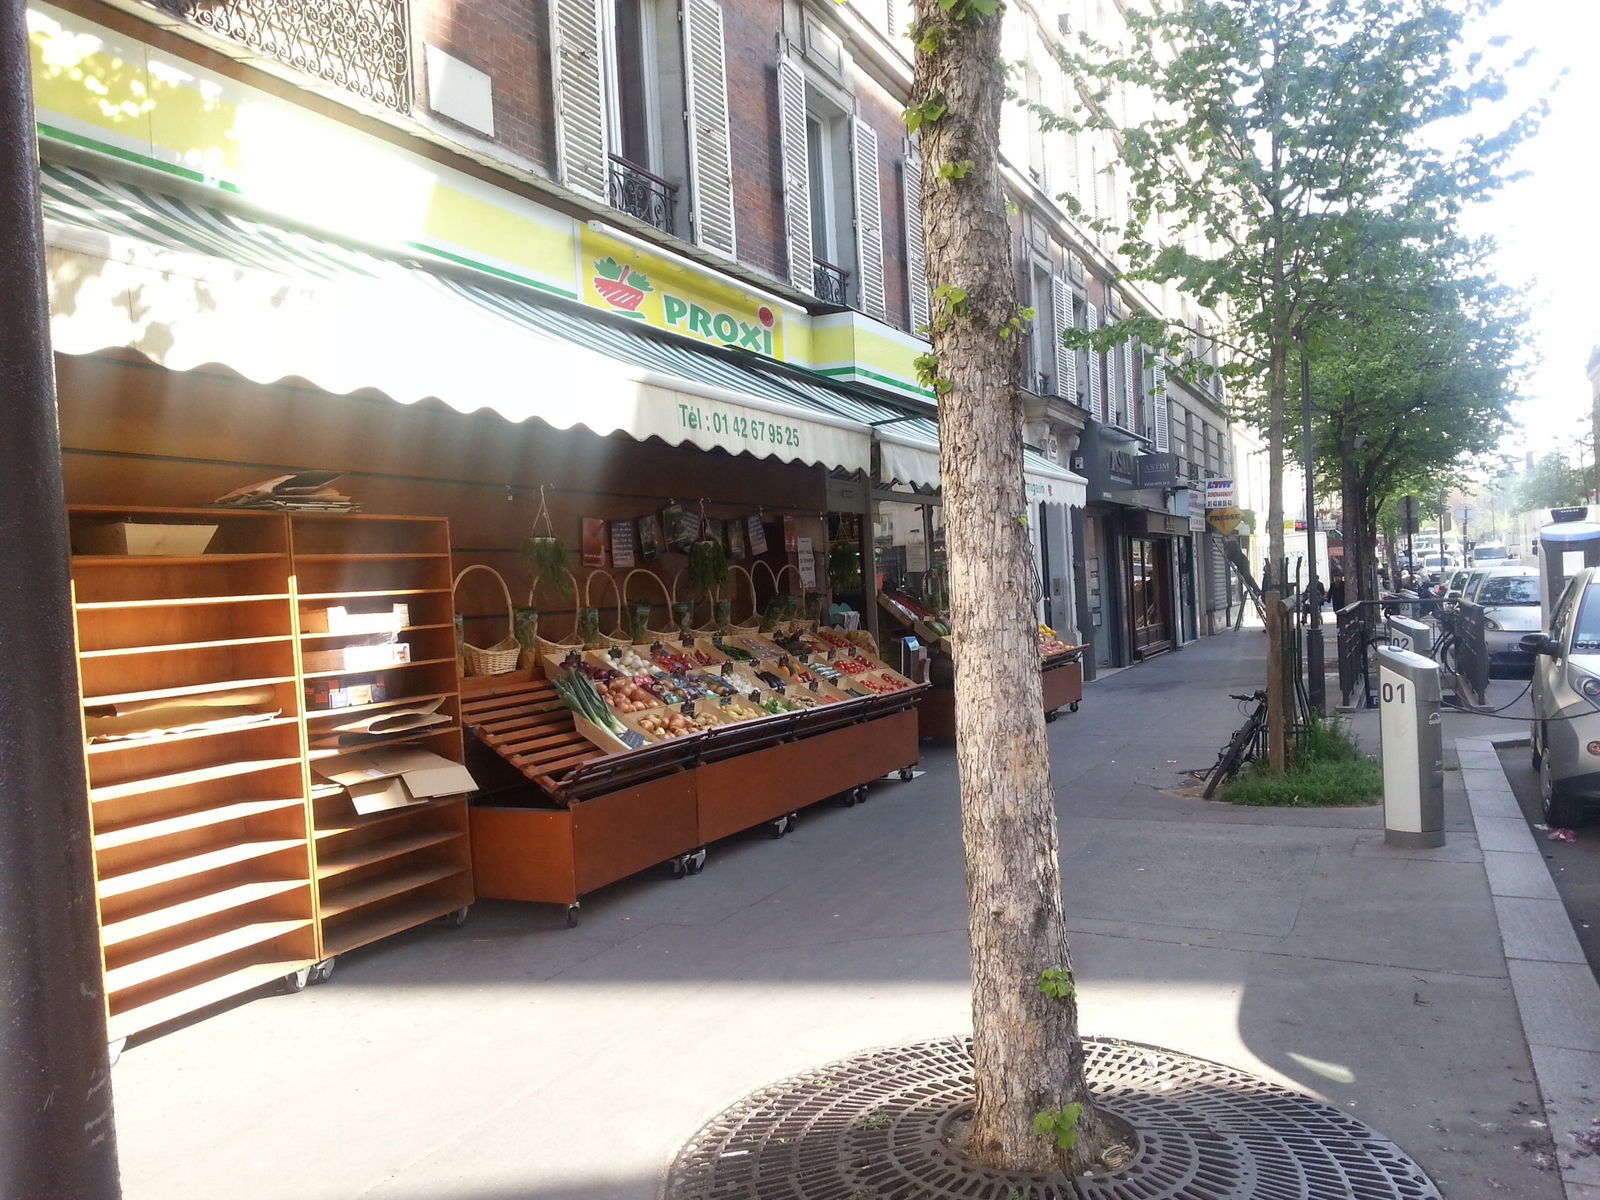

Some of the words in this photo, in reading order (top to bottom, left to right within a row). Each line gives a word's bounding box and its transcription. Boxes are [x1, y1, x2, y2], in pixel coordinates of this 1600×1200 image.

[713, 412, 729, 435] 01
[733, 416, 748, 439] 42
[751, 419, 766, 441] 67
[768, 423, 783, 445] 95
[785, 426, 800, 447] 25
[1392, 637, 1410, 650] 02
[1382, 682, 1406, 704] 01
